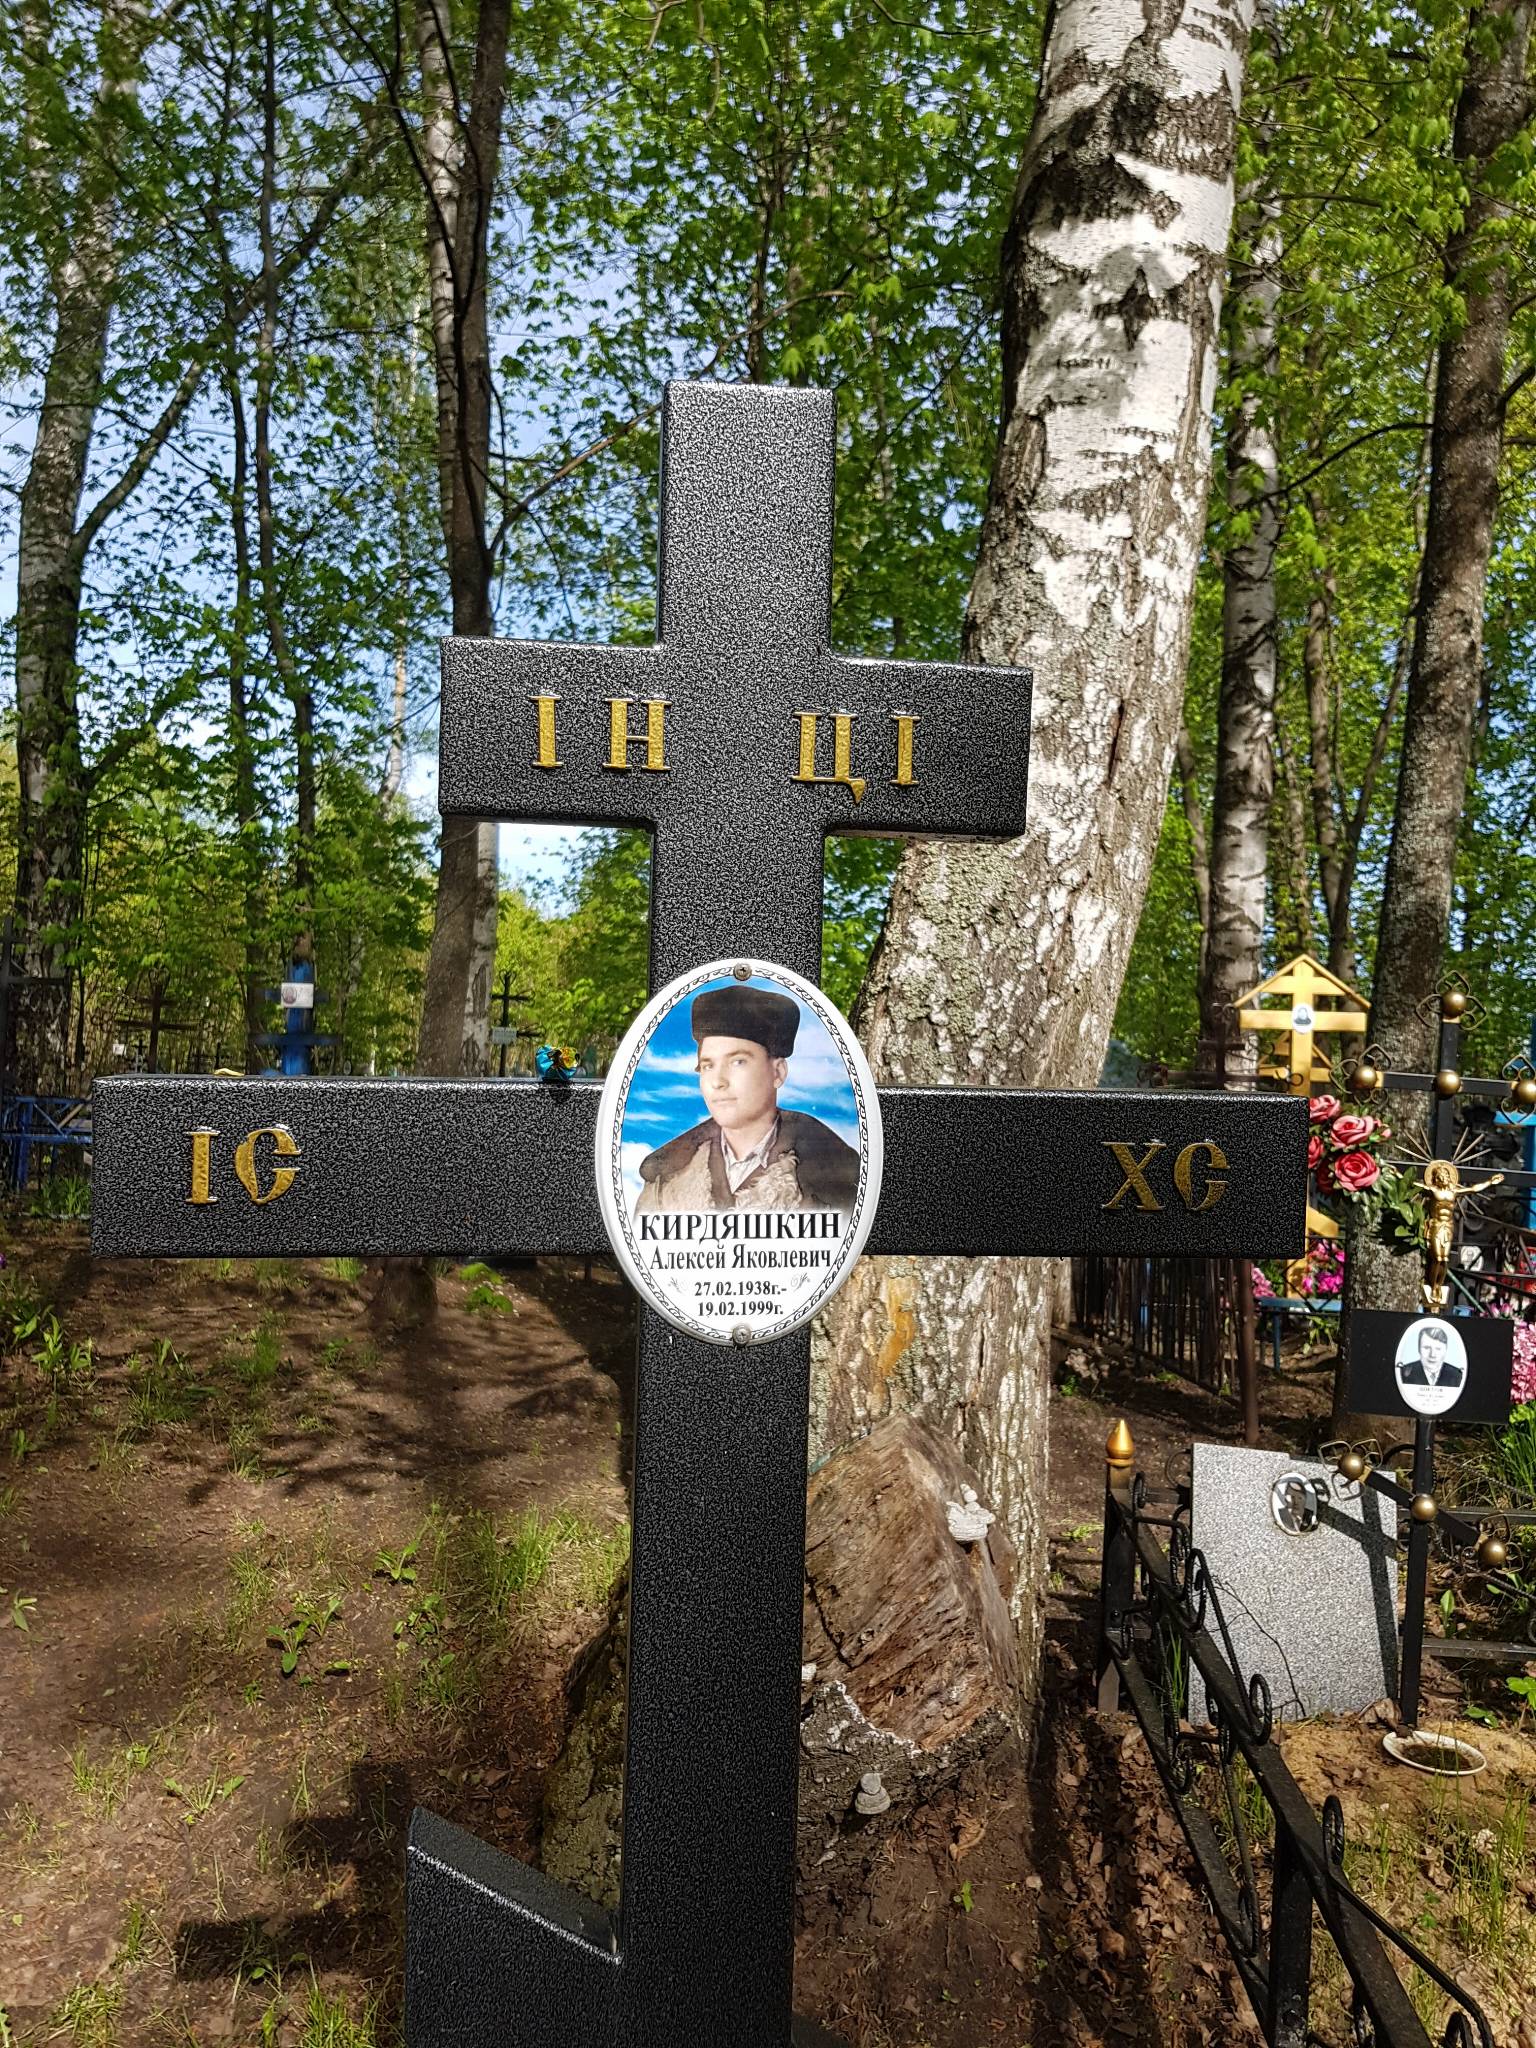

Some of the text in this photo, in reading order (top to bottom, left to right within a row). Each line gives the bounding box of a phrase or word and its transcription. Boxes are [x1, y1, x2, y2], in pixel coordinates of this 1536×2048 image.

[639, 1213, 841, 1245] КИРДЯШКИН
[650, 1243, 832, 1270] Алексей Яковлевич
[698, 1300, 784, 1317] 19.02.1999г.
